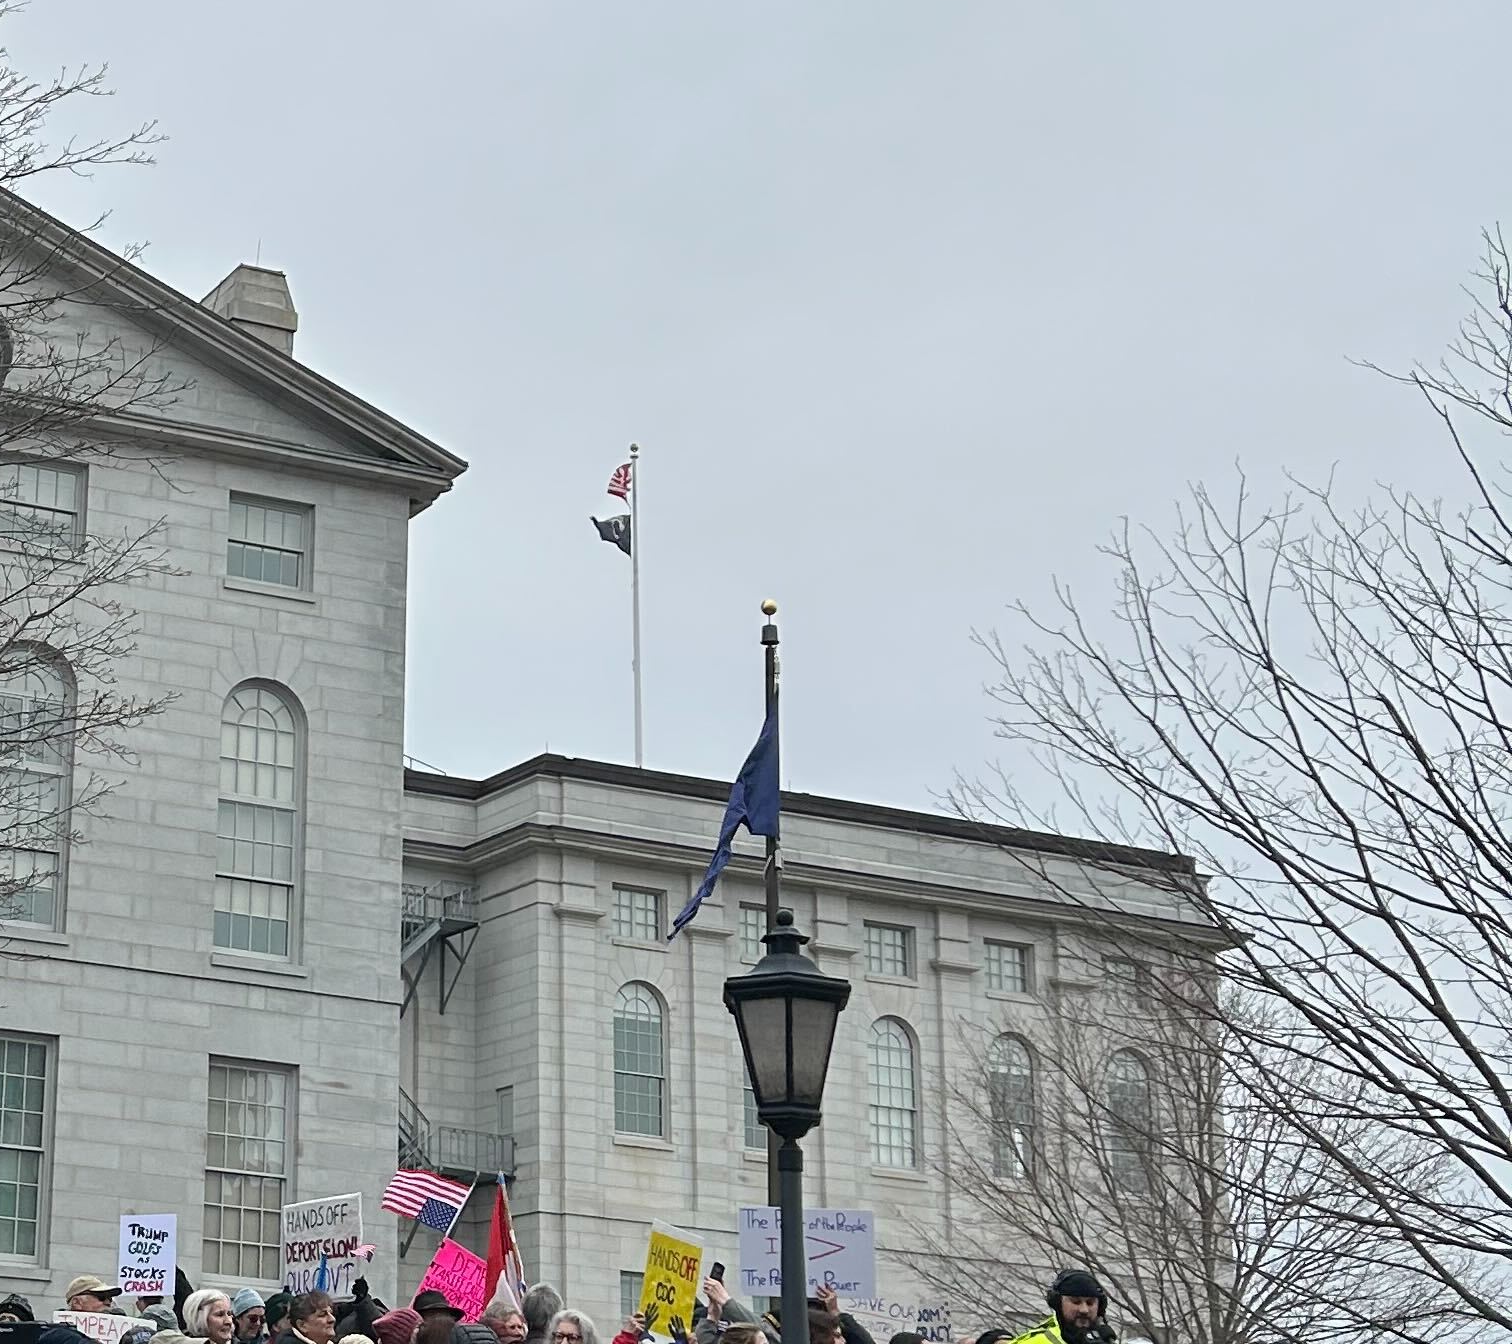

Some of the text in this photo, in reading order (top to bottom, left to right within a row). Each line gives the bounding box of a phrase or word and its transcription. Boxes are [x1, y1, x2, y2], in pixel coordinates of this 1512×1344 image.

[286, 1203, 348, 1234] HANDS OFF
[740, 1208, 769, 1230] The
[127, 1223, 169, 1243] TRUMP
[128, 1240, 163, 1256] GOLFS
[285, 1239, 323, 1264] DEPORT
[119, 1265, 167, 1279] STOCKS
[648, 1245, 699, 1283] HANDS OFF
[124, 1280, 164, 1293] CRASH
[741, 1269, 767, 1287] The
[655, 1281, 676, 1305] CDC
[847, 1297, 886, 1312] SAVE
[57, 1314, 139, 1339] IMPEAC
